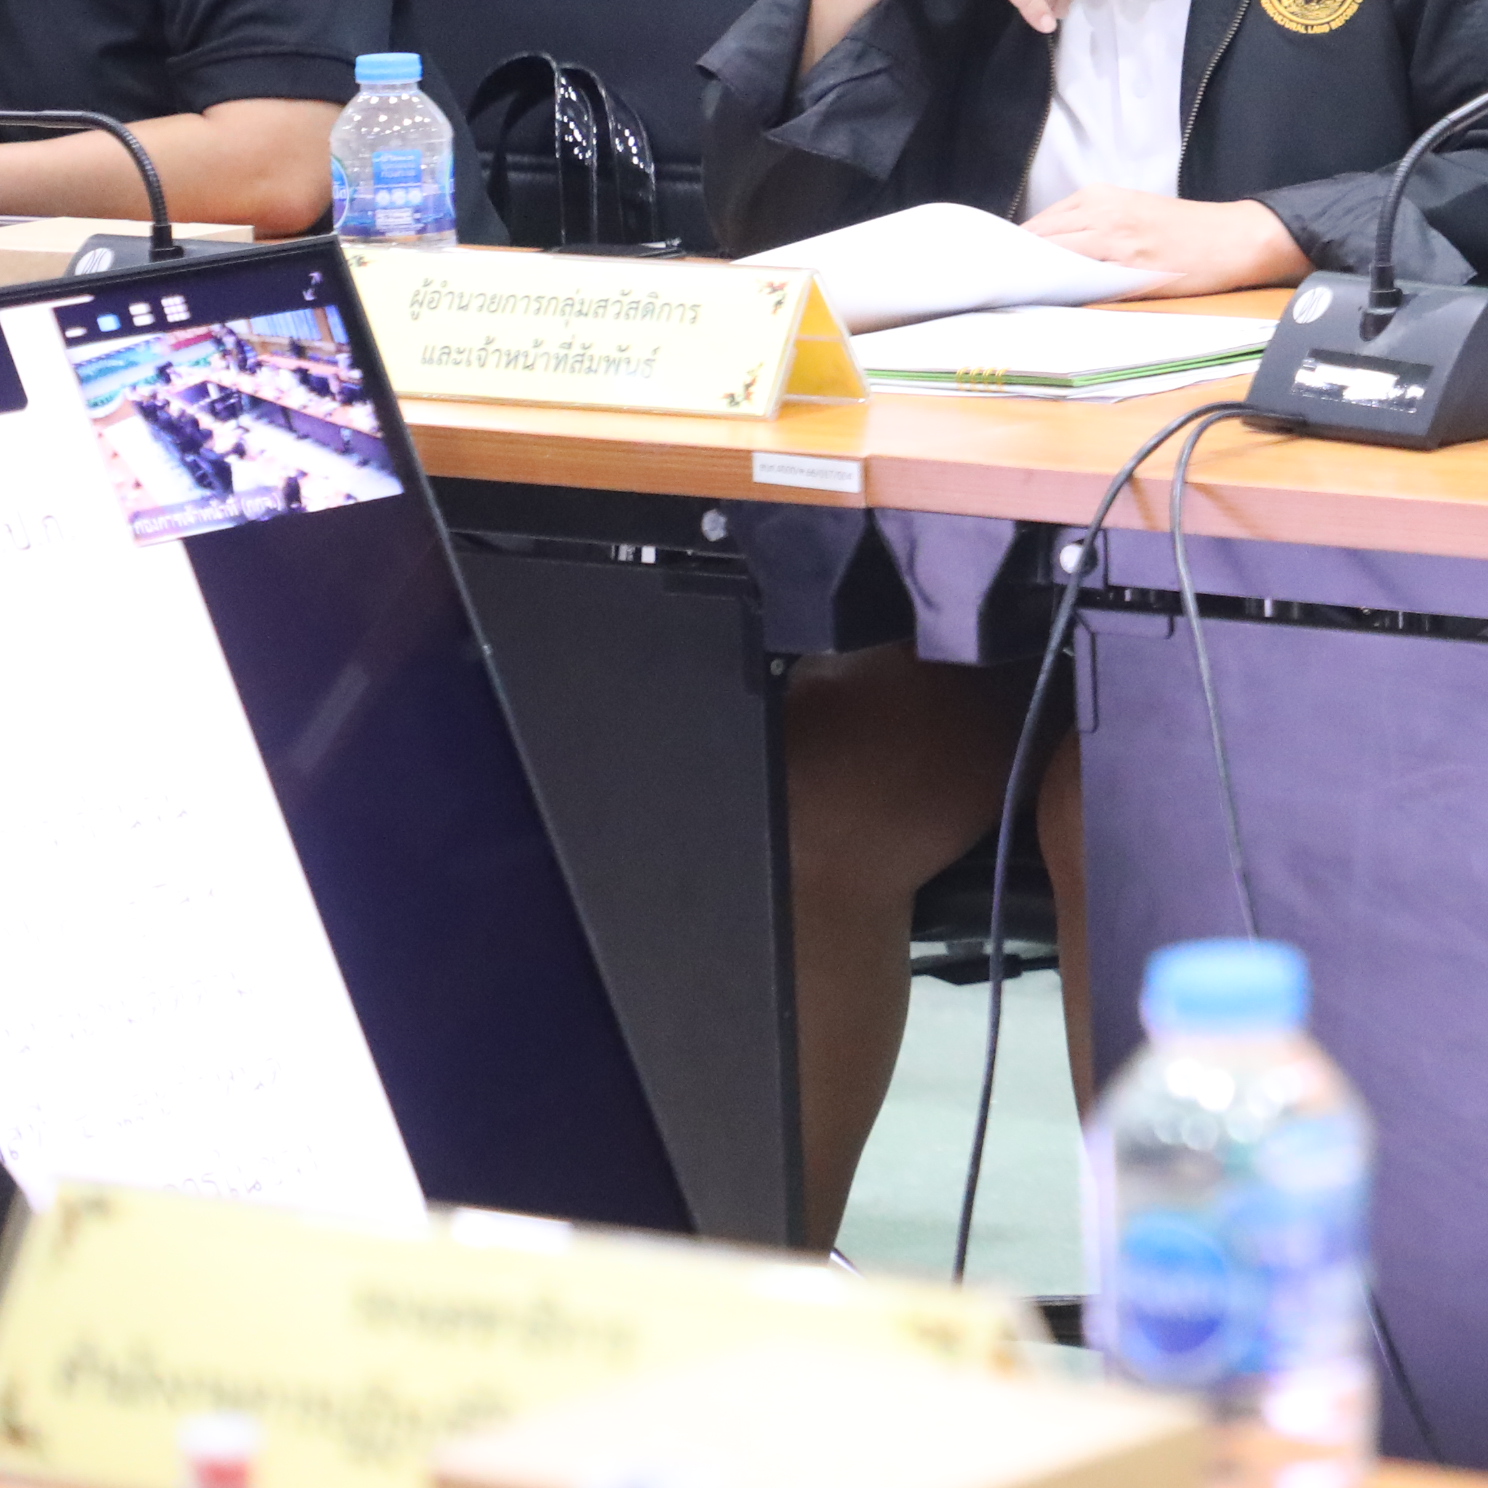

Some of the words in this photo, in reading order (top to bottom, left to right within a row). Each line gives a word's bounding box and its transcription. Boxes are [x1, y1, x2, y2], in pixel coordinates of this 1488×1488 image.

[409, 278, 702, 327] ผู้อำนวยการกลุ่มสวัสดิการ
